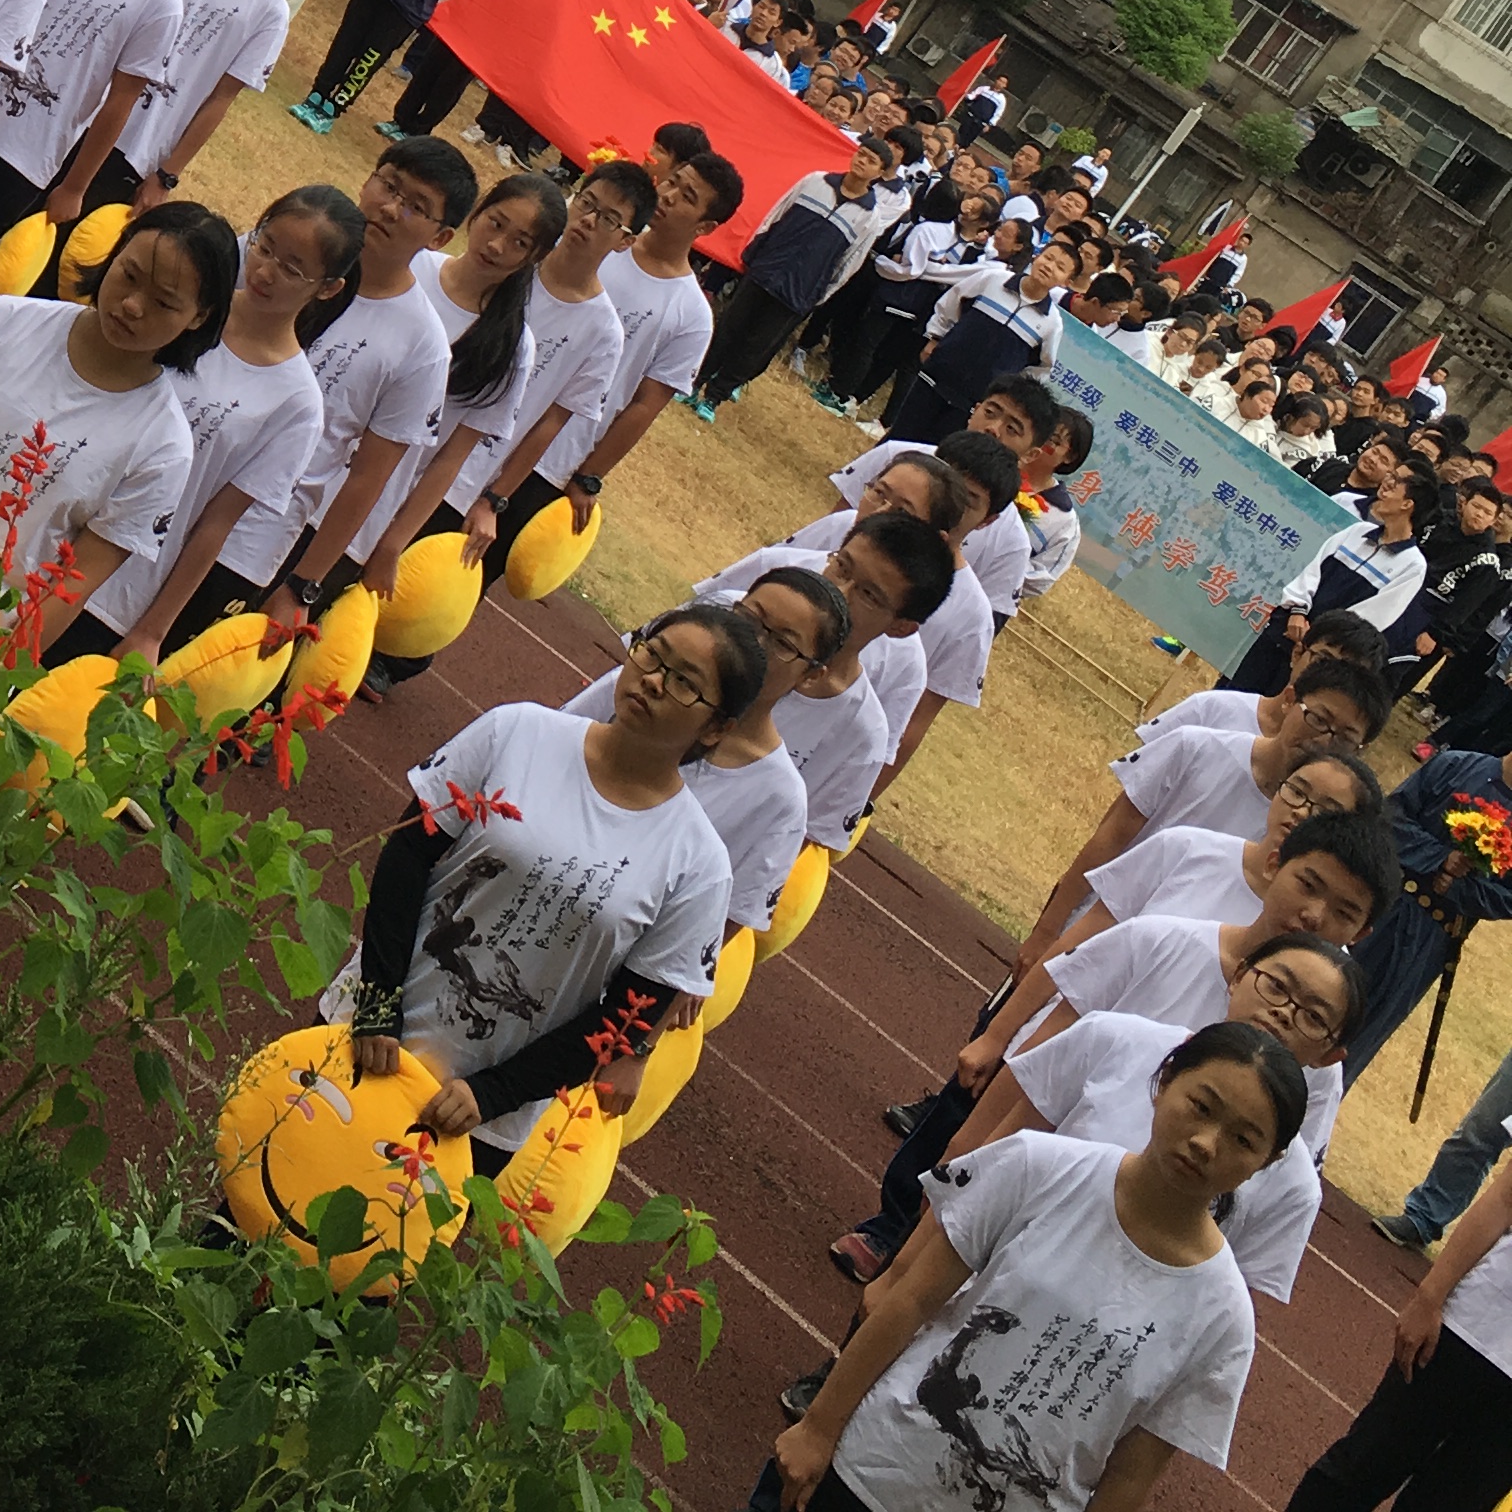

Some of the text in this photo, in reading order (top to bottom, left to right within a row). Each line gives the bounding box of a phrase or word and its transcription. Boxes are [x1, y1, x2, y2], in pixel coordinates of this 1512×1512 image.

[1113, 410, 1200, 478] 爱我三中
[1211, 480, 1303, 552] 爱我中华
[1119, 506, 1278, 634] 博学笃行
